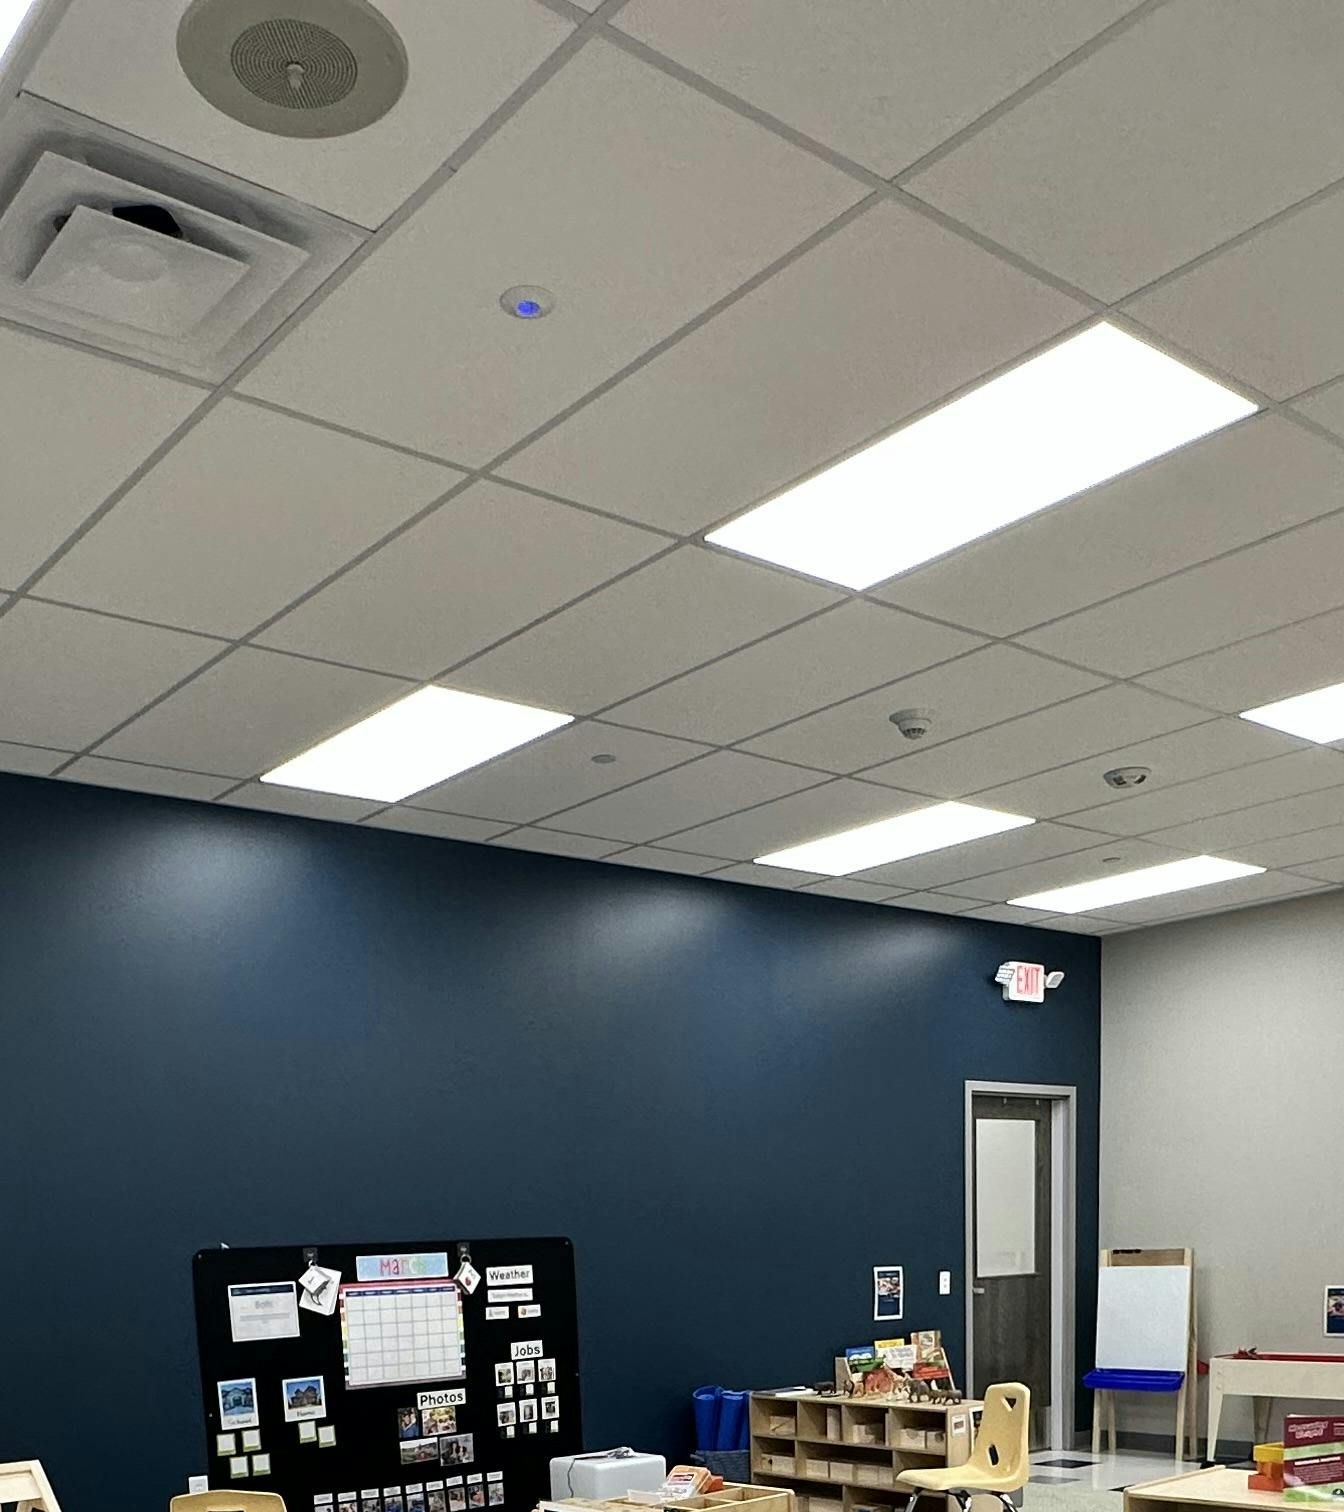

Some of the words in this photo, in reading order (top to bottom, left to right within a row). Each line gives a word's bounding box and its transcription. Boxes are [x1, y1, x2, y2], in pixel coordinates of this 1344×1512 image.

[1017, 965, 1041, 995] EXIT
[489, 1269, 530, 1280] Weather
[514, 1345, 541, 1357] Jobs
[419, 1391, 464, 1407] Photos
